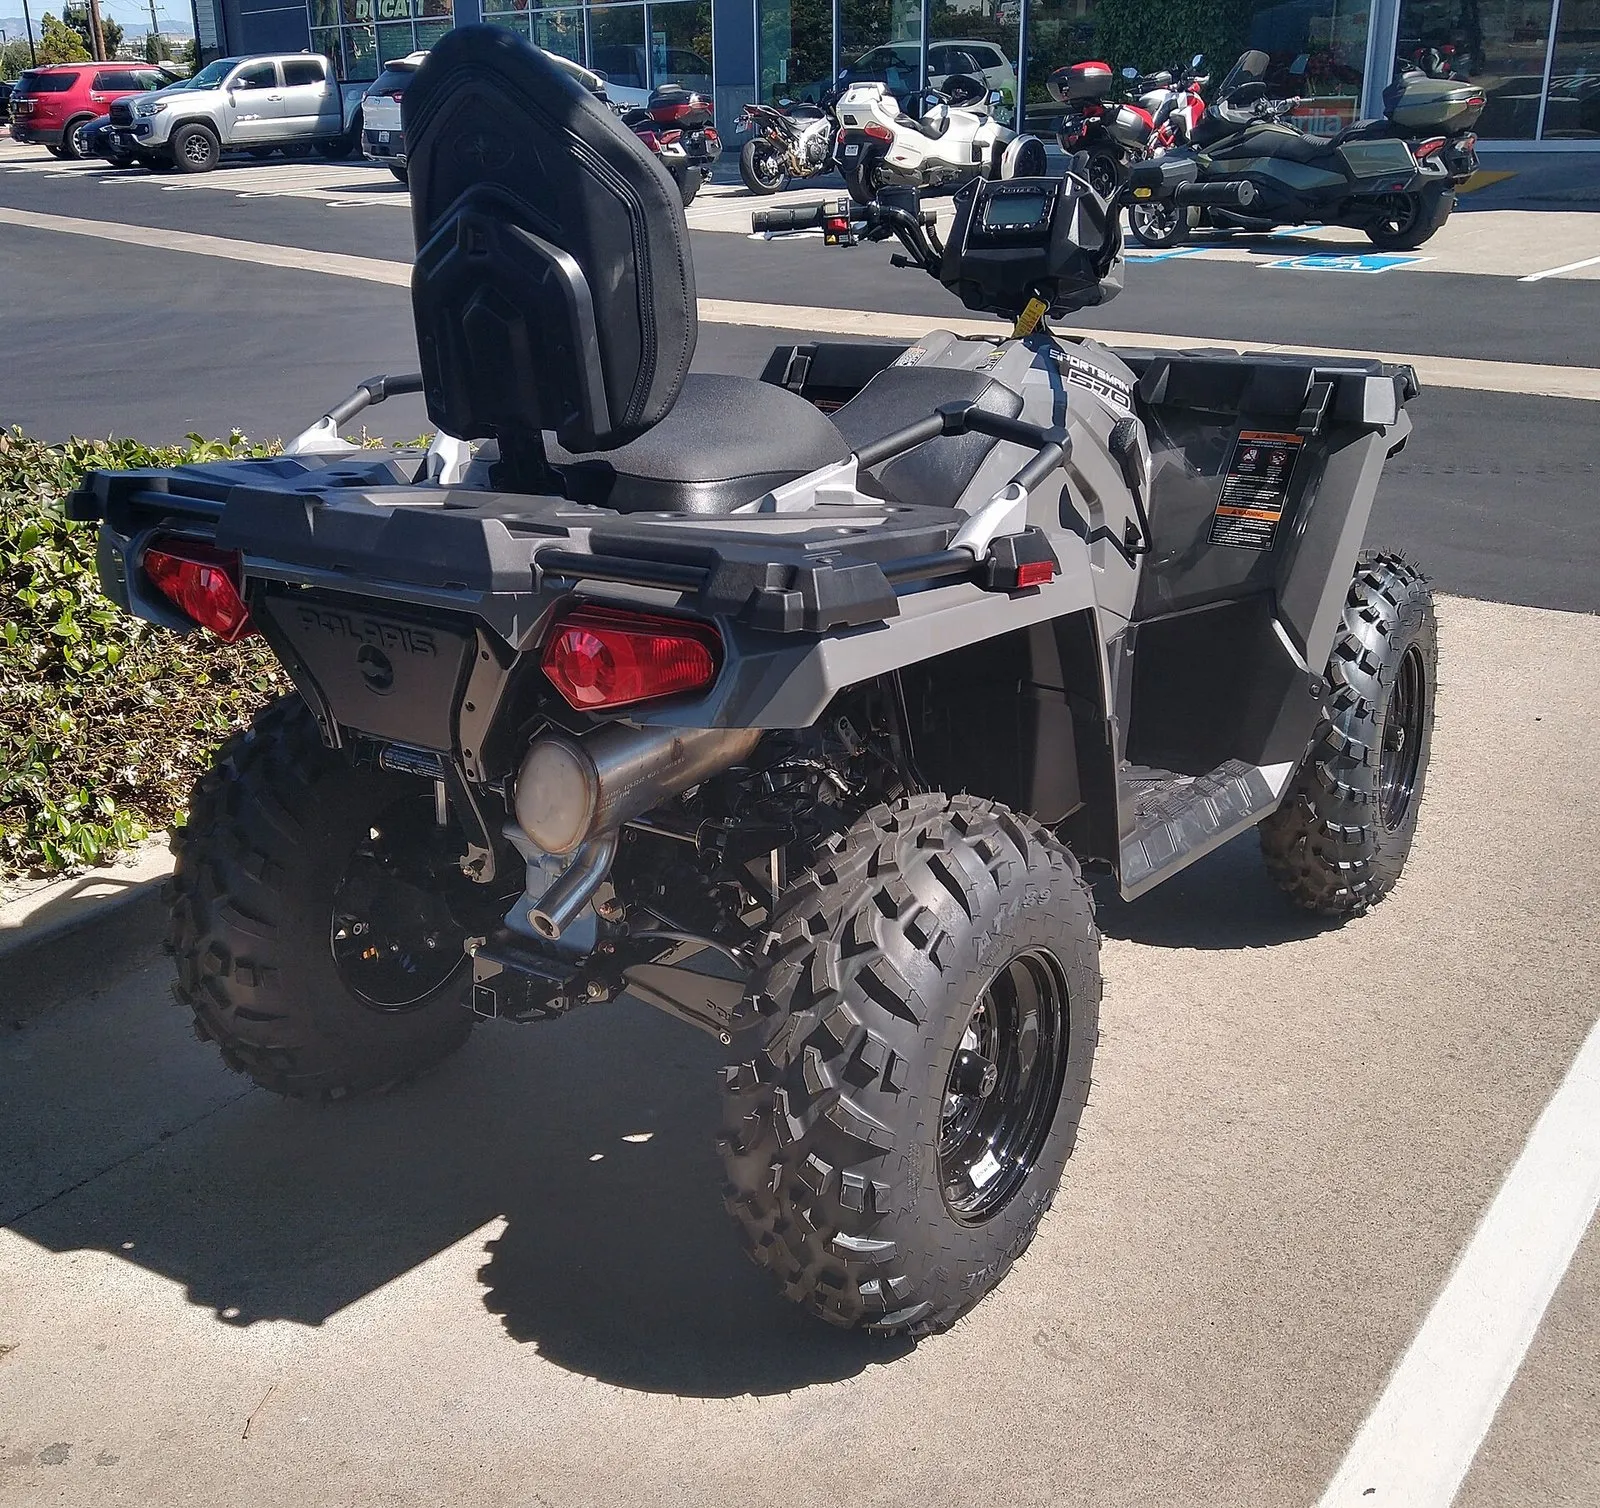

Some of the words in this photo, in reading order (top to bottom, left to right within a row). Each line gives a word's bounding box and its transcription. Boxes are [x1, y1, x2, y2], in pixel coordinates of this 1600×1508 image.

[1049, 349, 1130, 393] SPORTSMAN
[1067, 368, 1131, 411] 570
[297, 605, 437, 657] POLARIS
